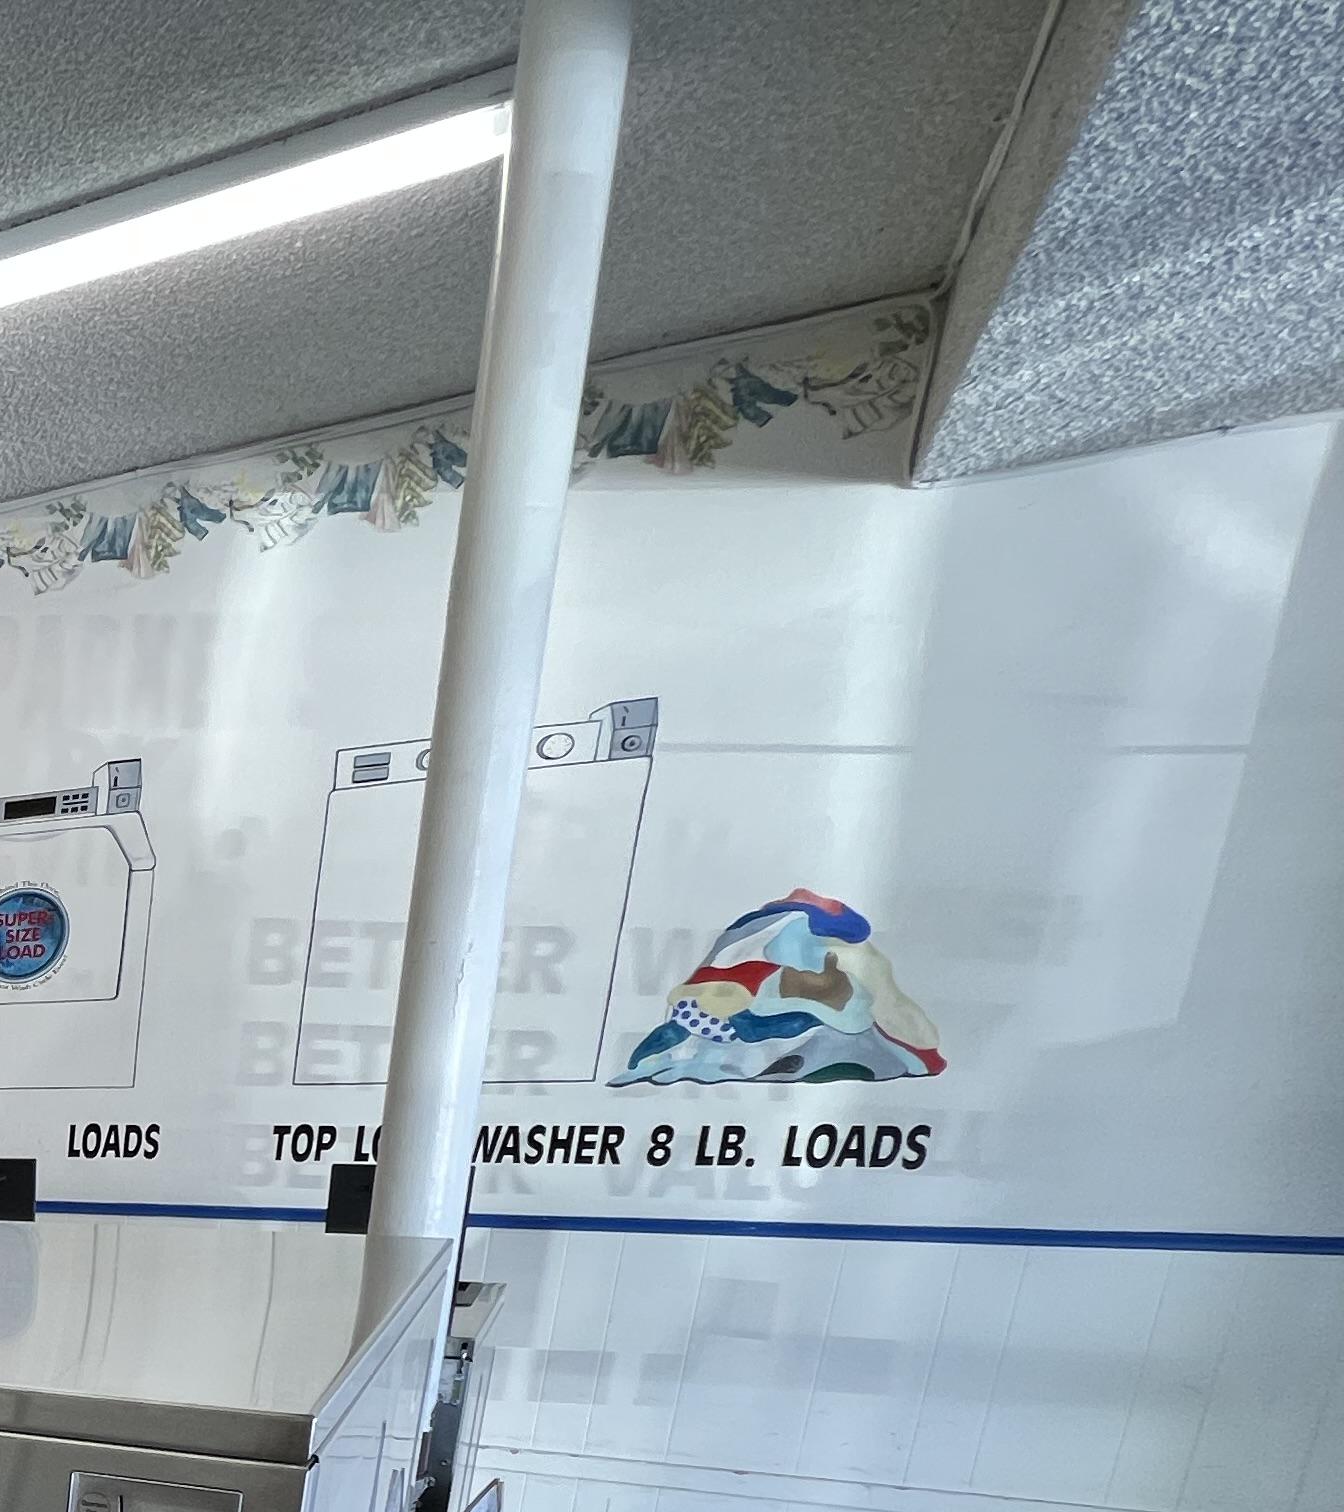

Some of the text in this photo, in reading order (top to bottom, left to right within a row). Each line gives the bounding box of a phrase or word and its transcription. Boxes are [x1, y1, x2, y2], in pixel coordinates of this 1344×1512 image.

[5, 928, 41, 944] SIZE
[67, 1122, 161, 1160] LOADS
[272, 1123, 338, 1163] TOP
[646, 1124, 675, 1167] 8
[695, 1125, 755, 1168] LB.
[782, 1123, 932, 1170] LOADS
